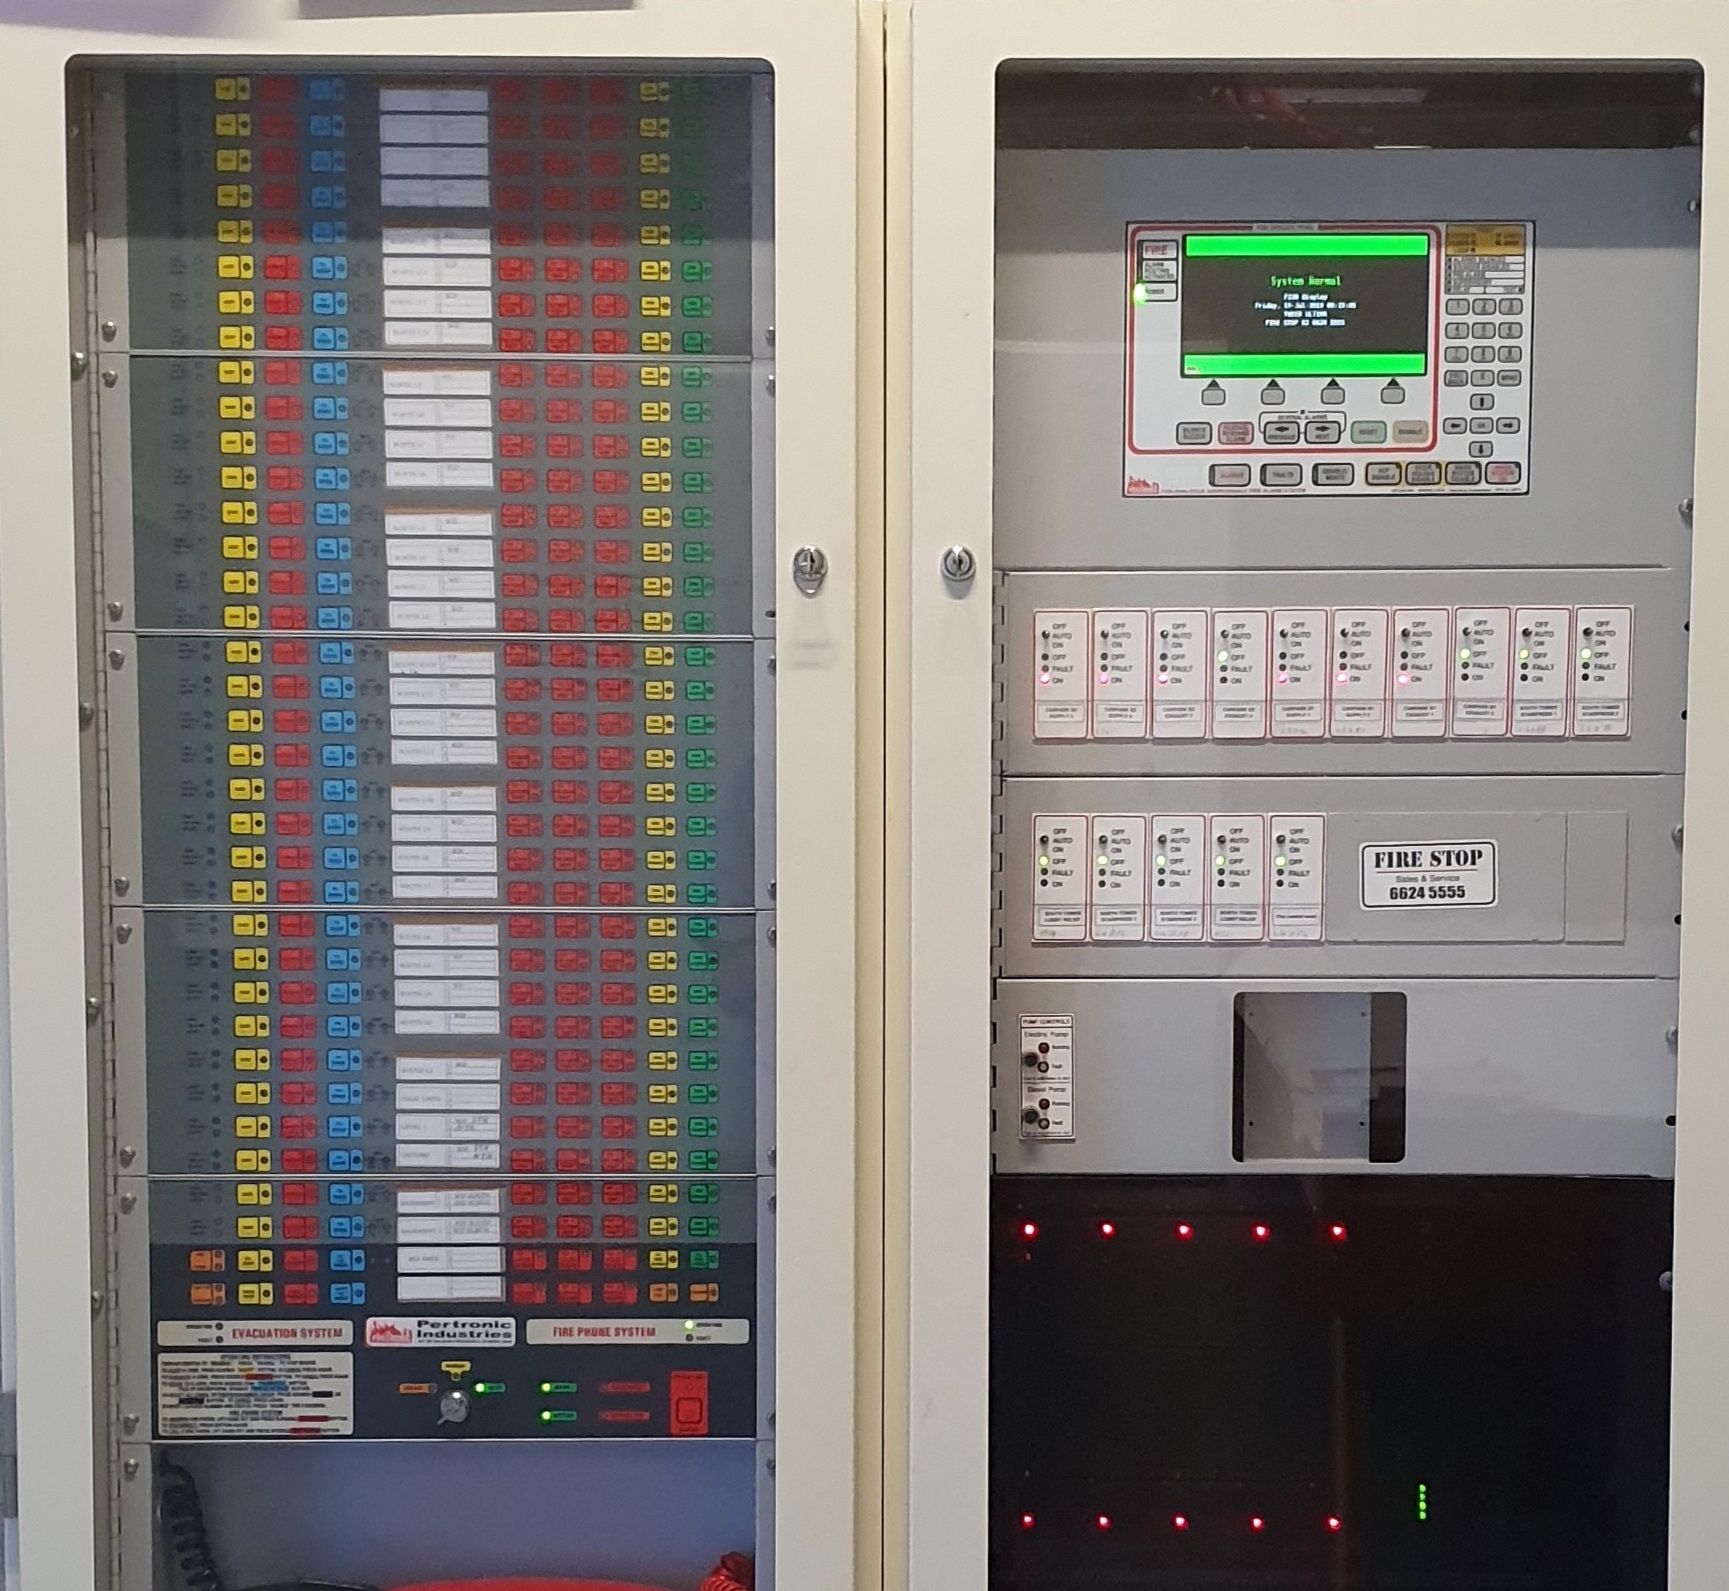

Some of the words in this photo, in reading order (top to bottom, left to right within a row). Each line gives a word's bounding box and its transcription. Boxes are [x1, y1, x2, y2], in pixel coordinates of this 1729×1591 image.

[1270, 275, 1304, 287] System
[1308, 275, 1341, 286] Normal
[1375, 851, 1423, 868] FIRE
[1429, 850, 1483, 867] STOP
[1390, 887, 1425, 900] 6624
[1428, 885, 1466, 899] 5555
[417, 1320, 512, 1329] Pertronic
[233, 1328, 297, 1339] EVACUATION
[301, 1327, 343, 1338] SYSTEM
[417, 1330, 512, 1338] Industries
[553, 1327, 574, 1337] FIRE
[577, 1326, 611, 1337] PHONE
[614, 1326, 656, 1337] SYSTEM
